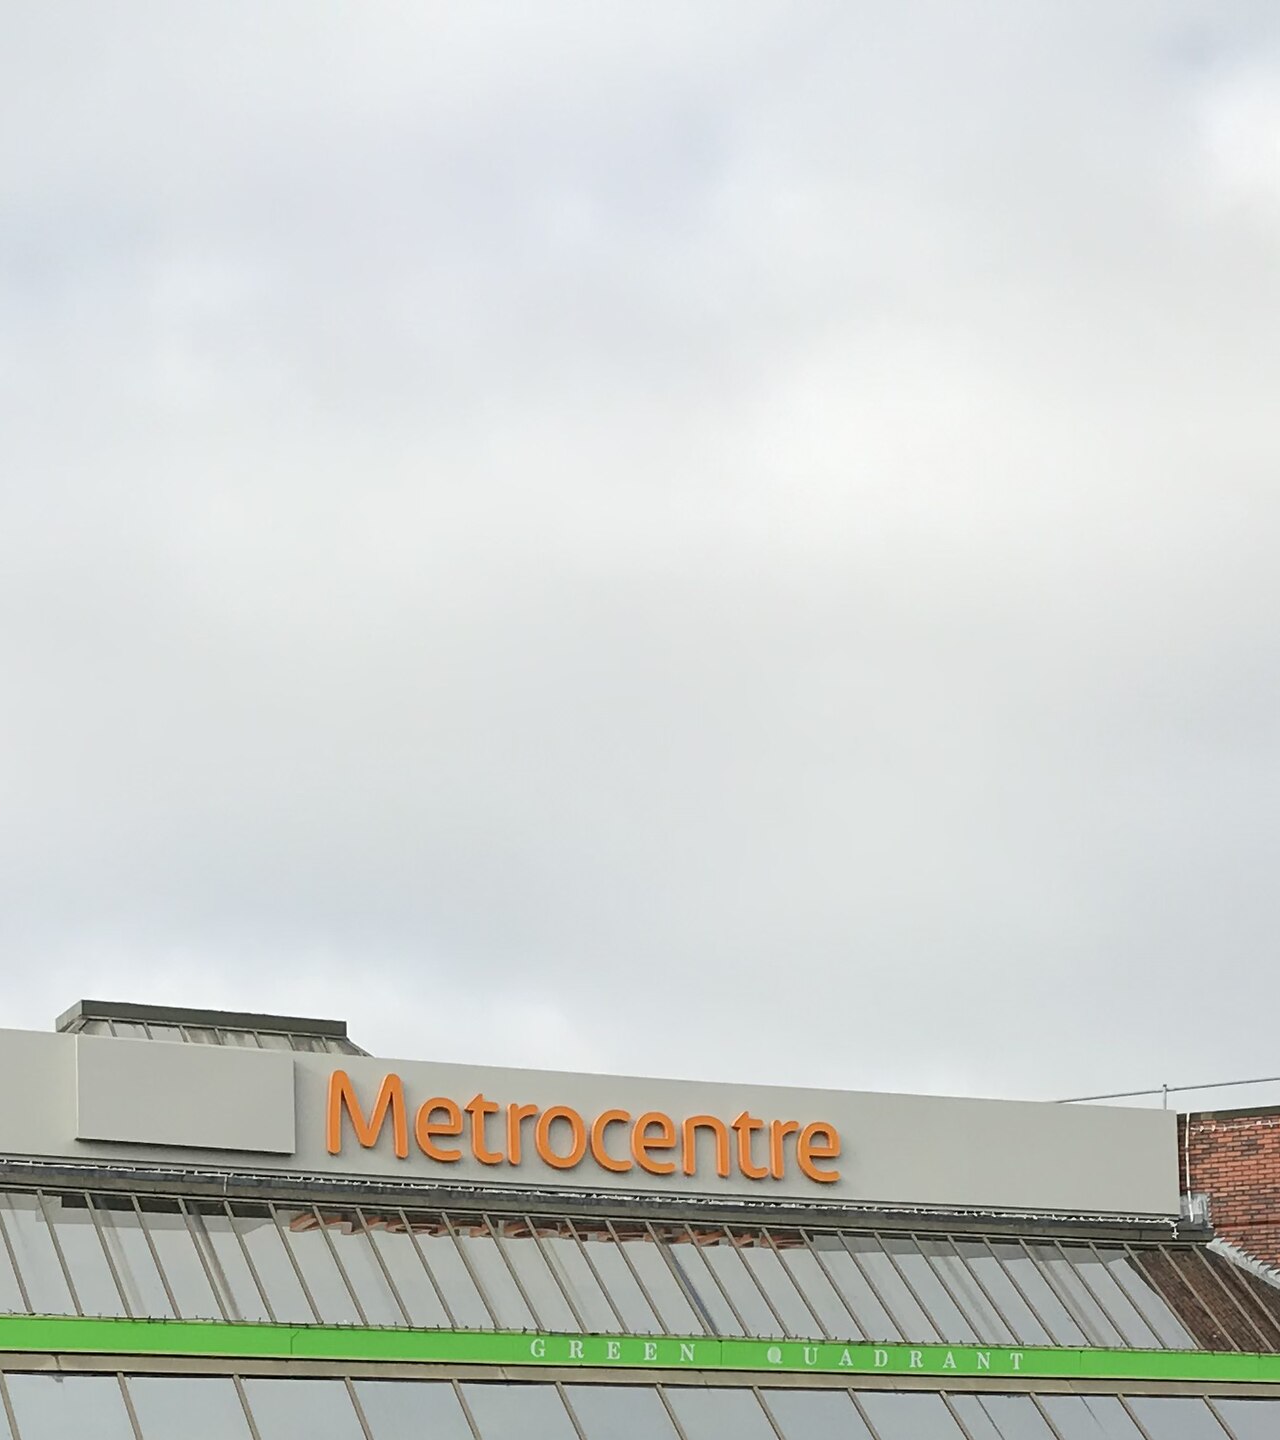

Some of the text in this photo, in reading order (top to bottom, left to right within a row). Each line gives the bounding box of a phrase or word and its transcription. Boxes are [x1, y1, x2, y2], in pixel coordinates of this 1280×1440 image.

[325, 1068, 842, 1184] Metrocentre
[529, 1337, 1026, 1371] GREEN QUADRANT
